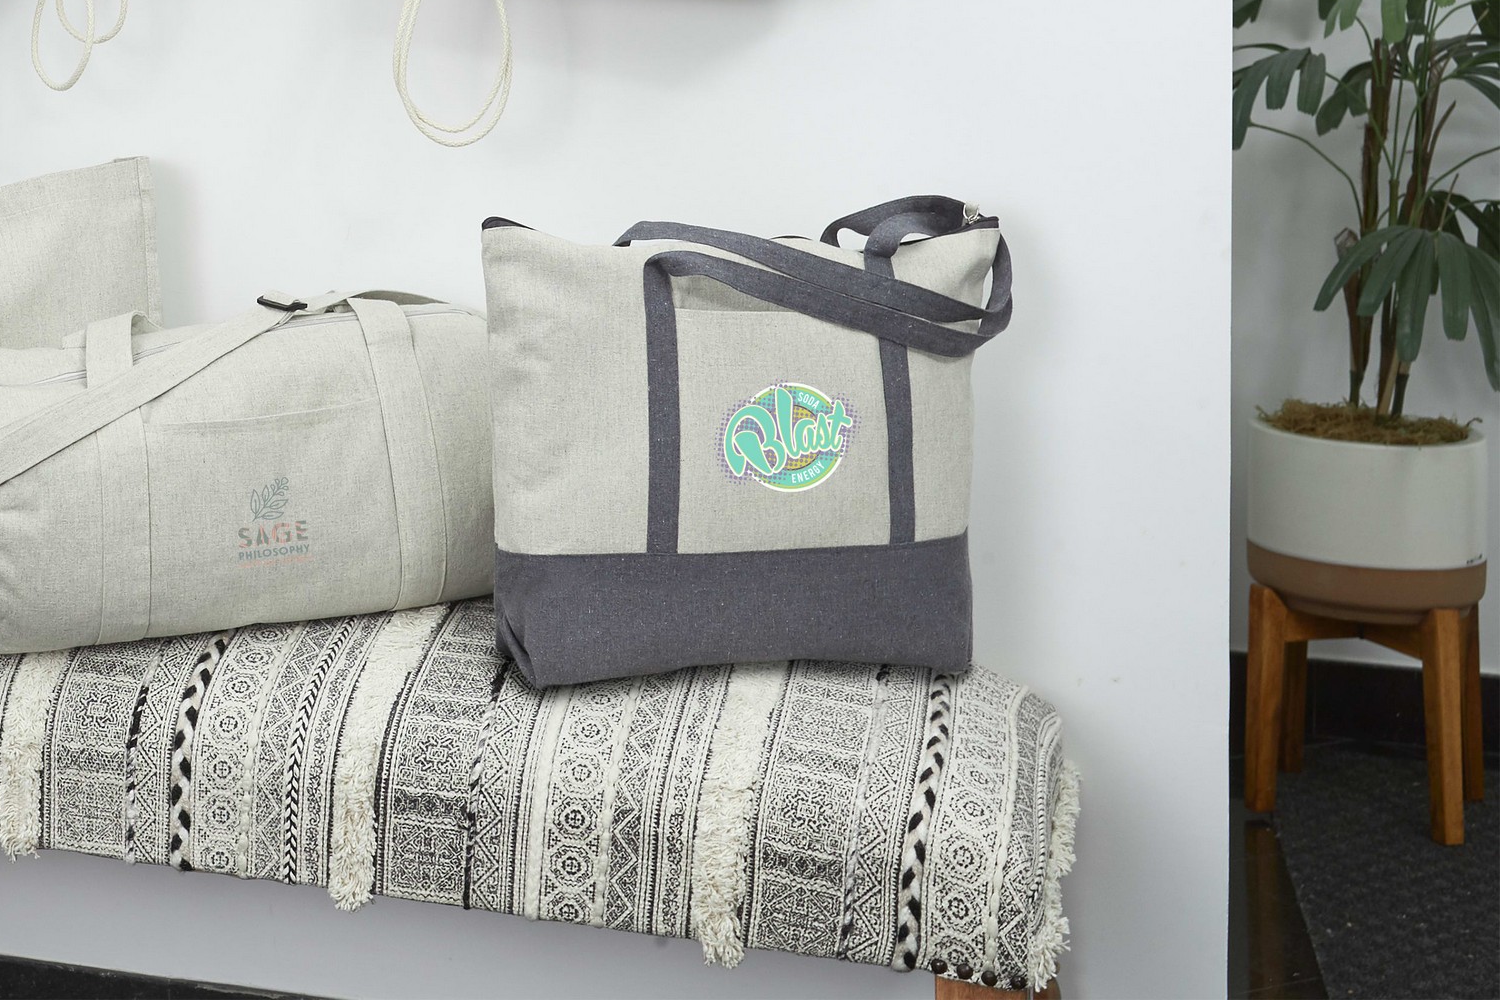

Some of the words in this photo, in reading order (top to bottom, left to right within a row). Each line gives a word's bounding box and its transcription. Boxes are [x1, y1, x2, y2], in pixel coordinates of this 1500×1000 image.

[797, 391, 820, 410] SODA
[724, 385, 854, 478] Blast
[791, 459, 825, 484] ENERGY
[237, 519, 310, 549] SAGE
[238, 543, 311, 561] PHILOSOPHY
